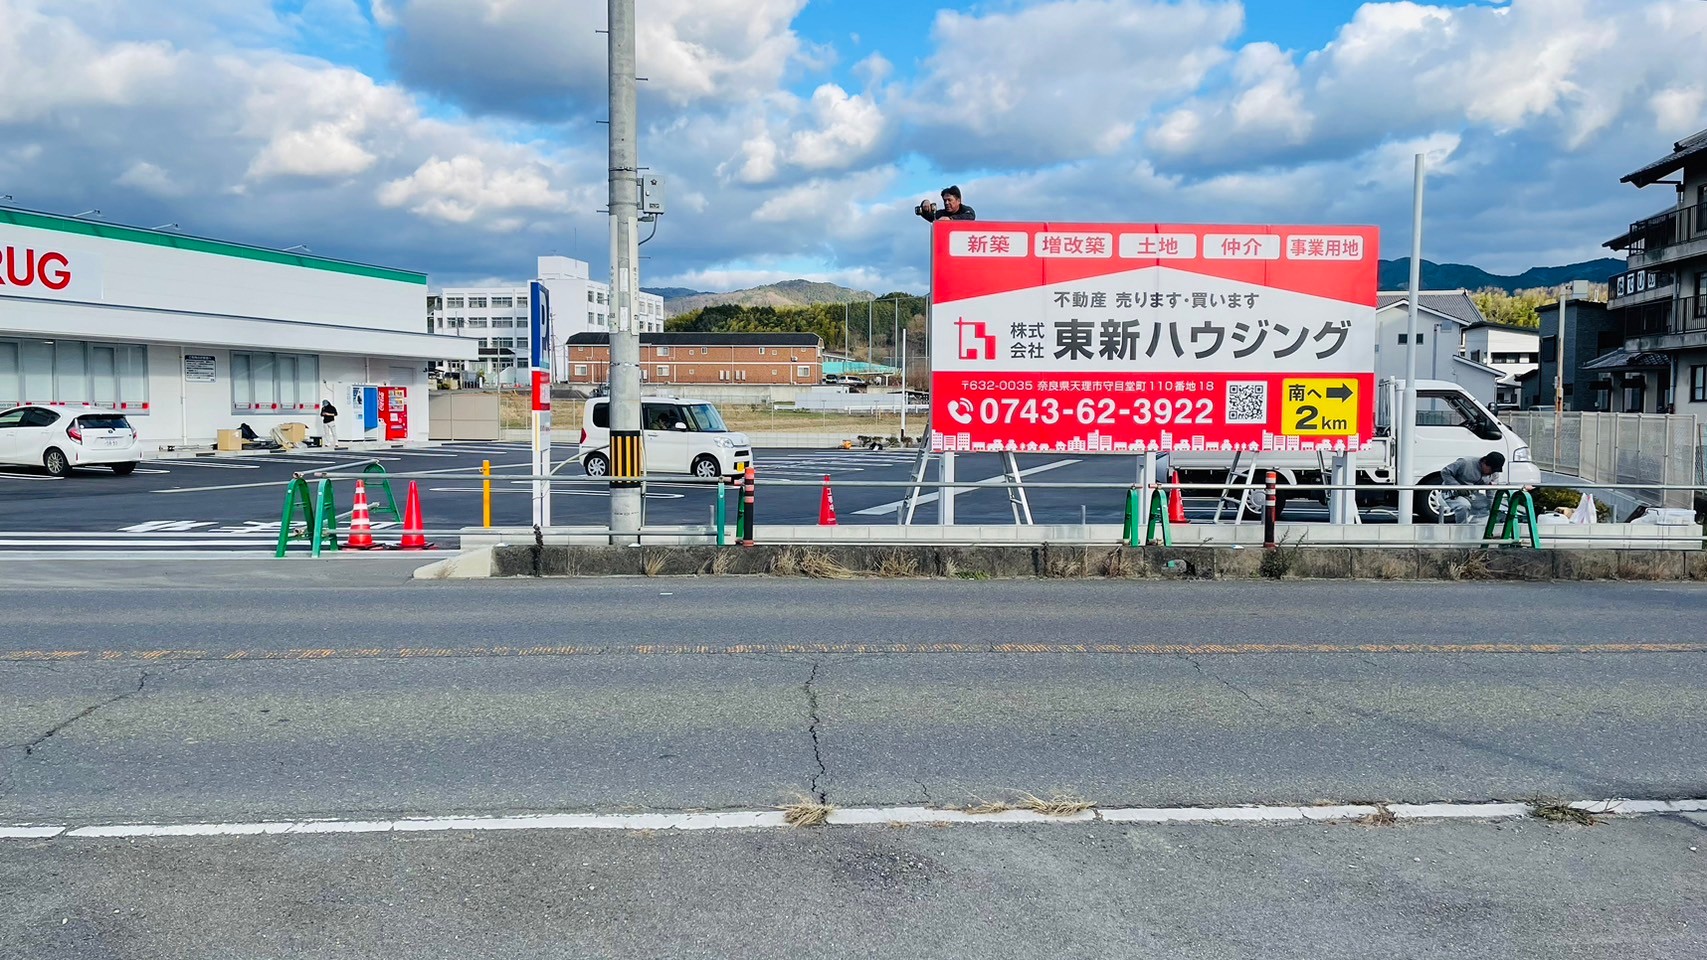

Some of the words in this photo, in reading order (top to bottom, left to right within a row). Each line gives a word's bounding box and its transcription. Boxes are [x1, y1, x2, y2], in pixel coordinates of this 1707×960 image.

[967, 235, 1010, 254] 新築
[1042, 236, 1105, 254] 増改築
[1137, 237, 1178, 255] 土地
[1221, 238, 1262, 256] 仲介
[1290, 239, 1359, 257] 事業用地
[0, 246, 71, 290] UG
[1054, 291, 1107, 308] 不動産
[1010, 322, 1045, 339] 株式
[1053, 318, 1352, 361] 東新ハウジング
[1010, 342, 1045, 359] 会社
[1288, 384, 1322, 402] 南へ
[980, 397, 1214, 425] 0743-62-3922
